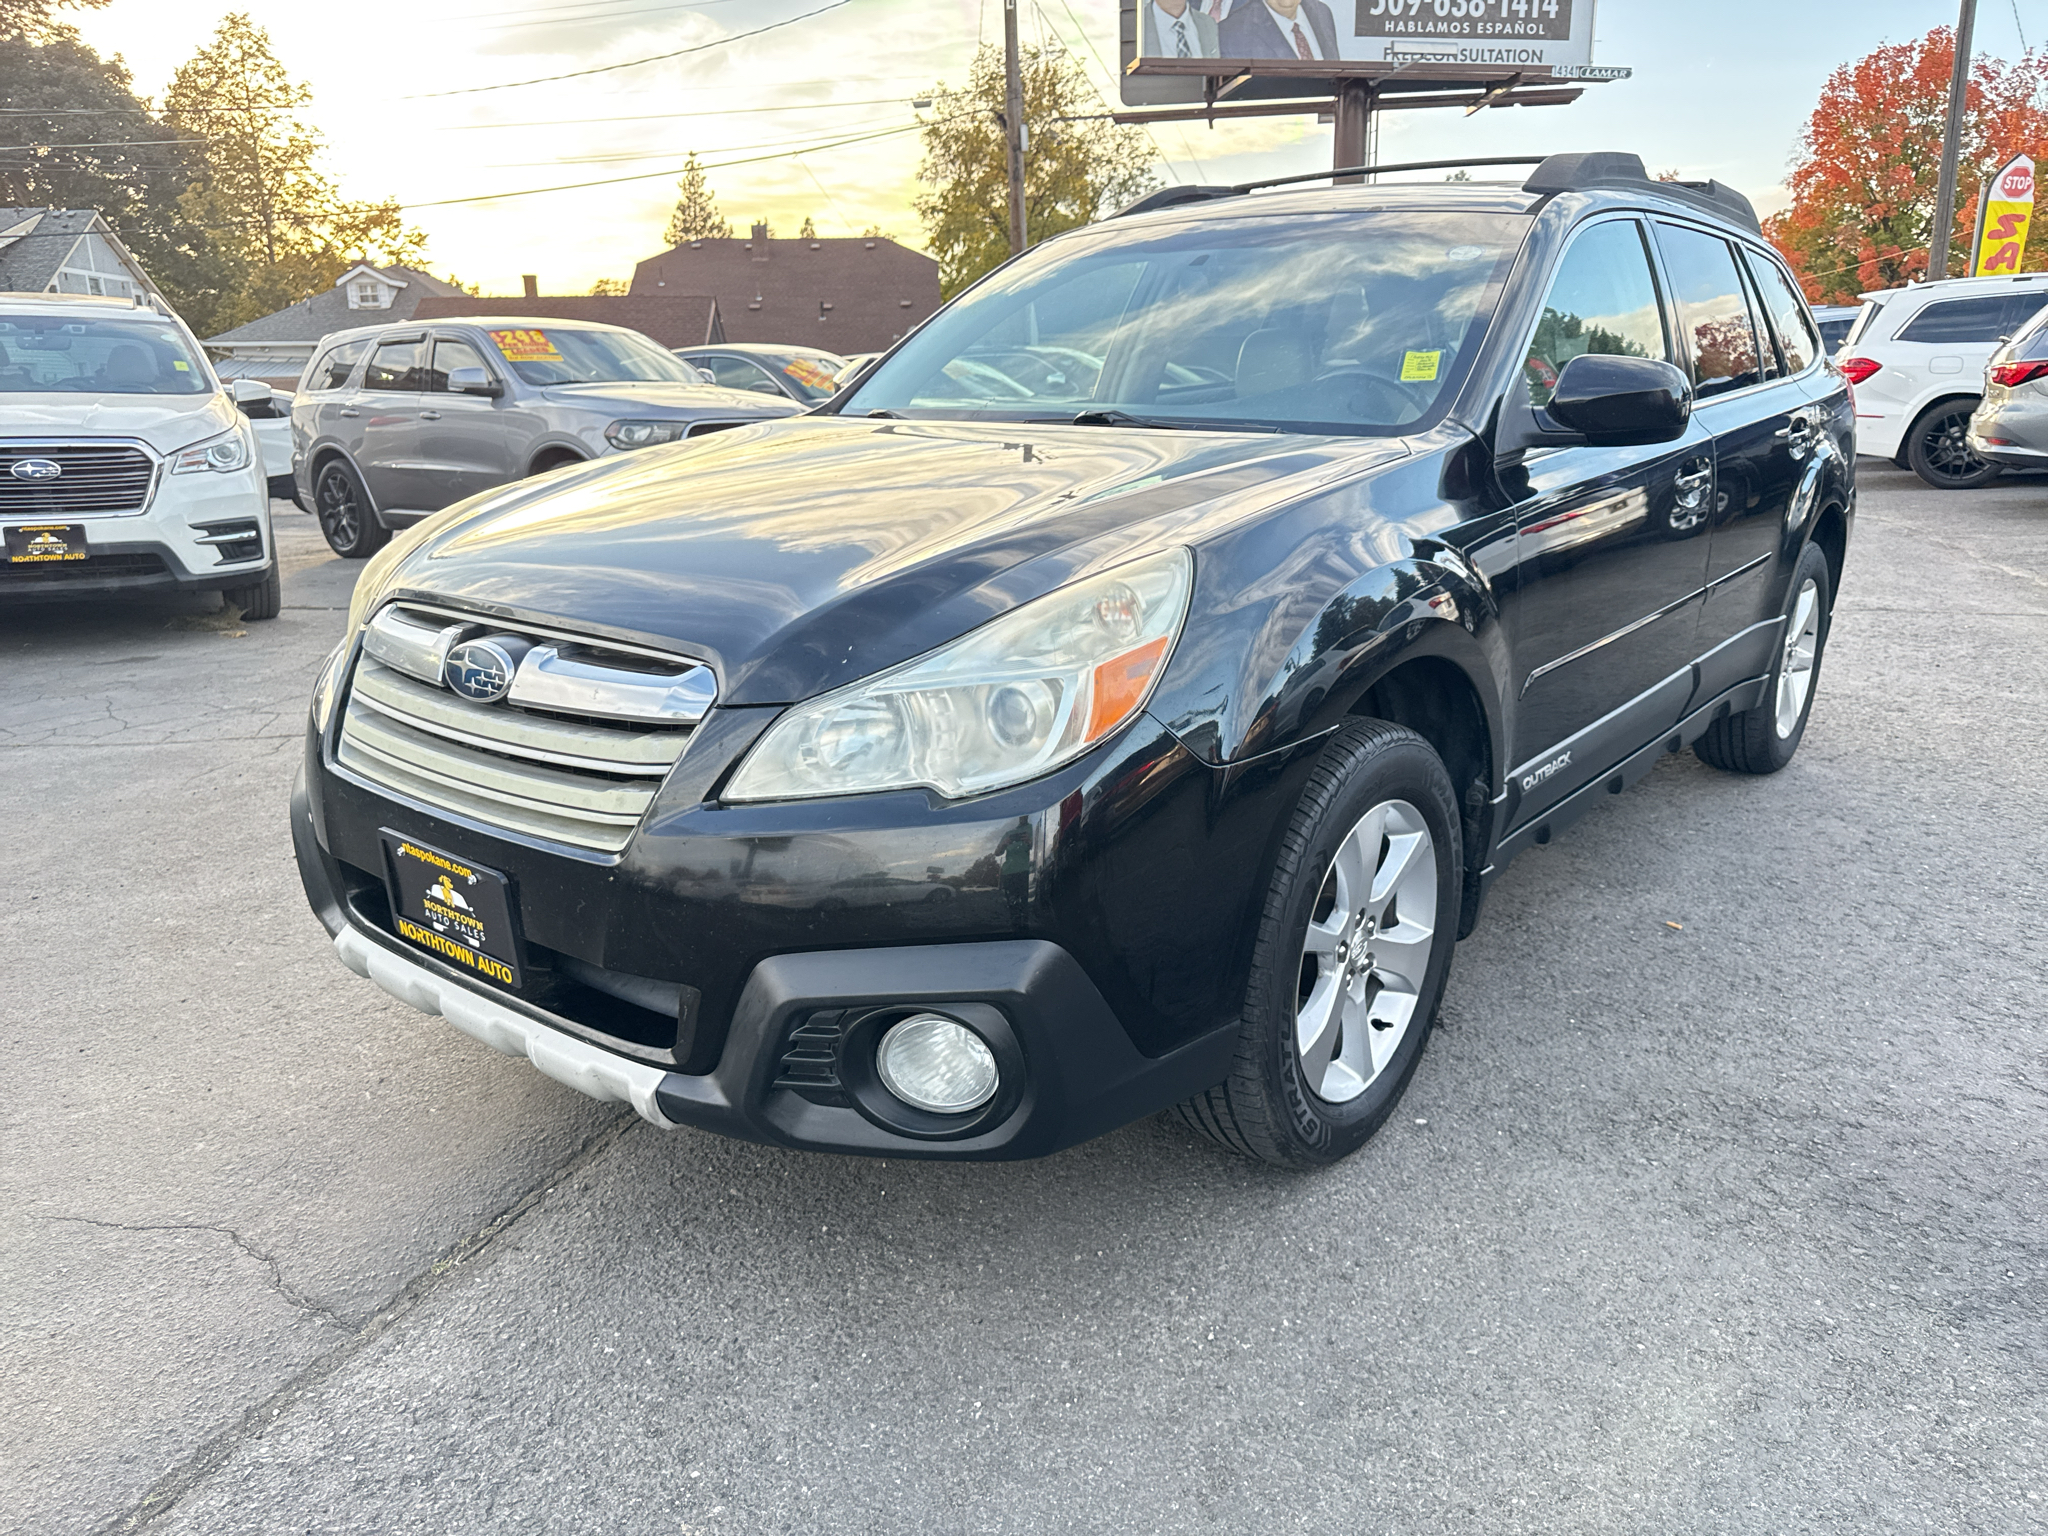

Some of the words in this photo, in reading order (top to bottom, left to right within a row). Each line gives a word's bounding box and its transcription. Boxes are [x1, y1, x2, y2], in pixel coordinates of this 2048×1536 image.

[1384, 20, 1471, 34] HABLAMOS
[1476, 21, 1546, 35] ESPAÑOL
[1585, 69, 1628, 78] LAMAR
[2004, 175, 2032, 190] STOP
[12, 554, 63, 563] NORTHTOWN
[1522, 751, 1572, 791] OUTBACK
[402, 843, 472, 877] ntaspokane.com
[423, 898, 484, 931] NORTHTOWN
[425, 908, 450, 926] AUTO
[454, 921, 486, 941] SALES
[398, 919, 475, 967] NORTHTOWN
[478, 955, 513, 984] AUTO
